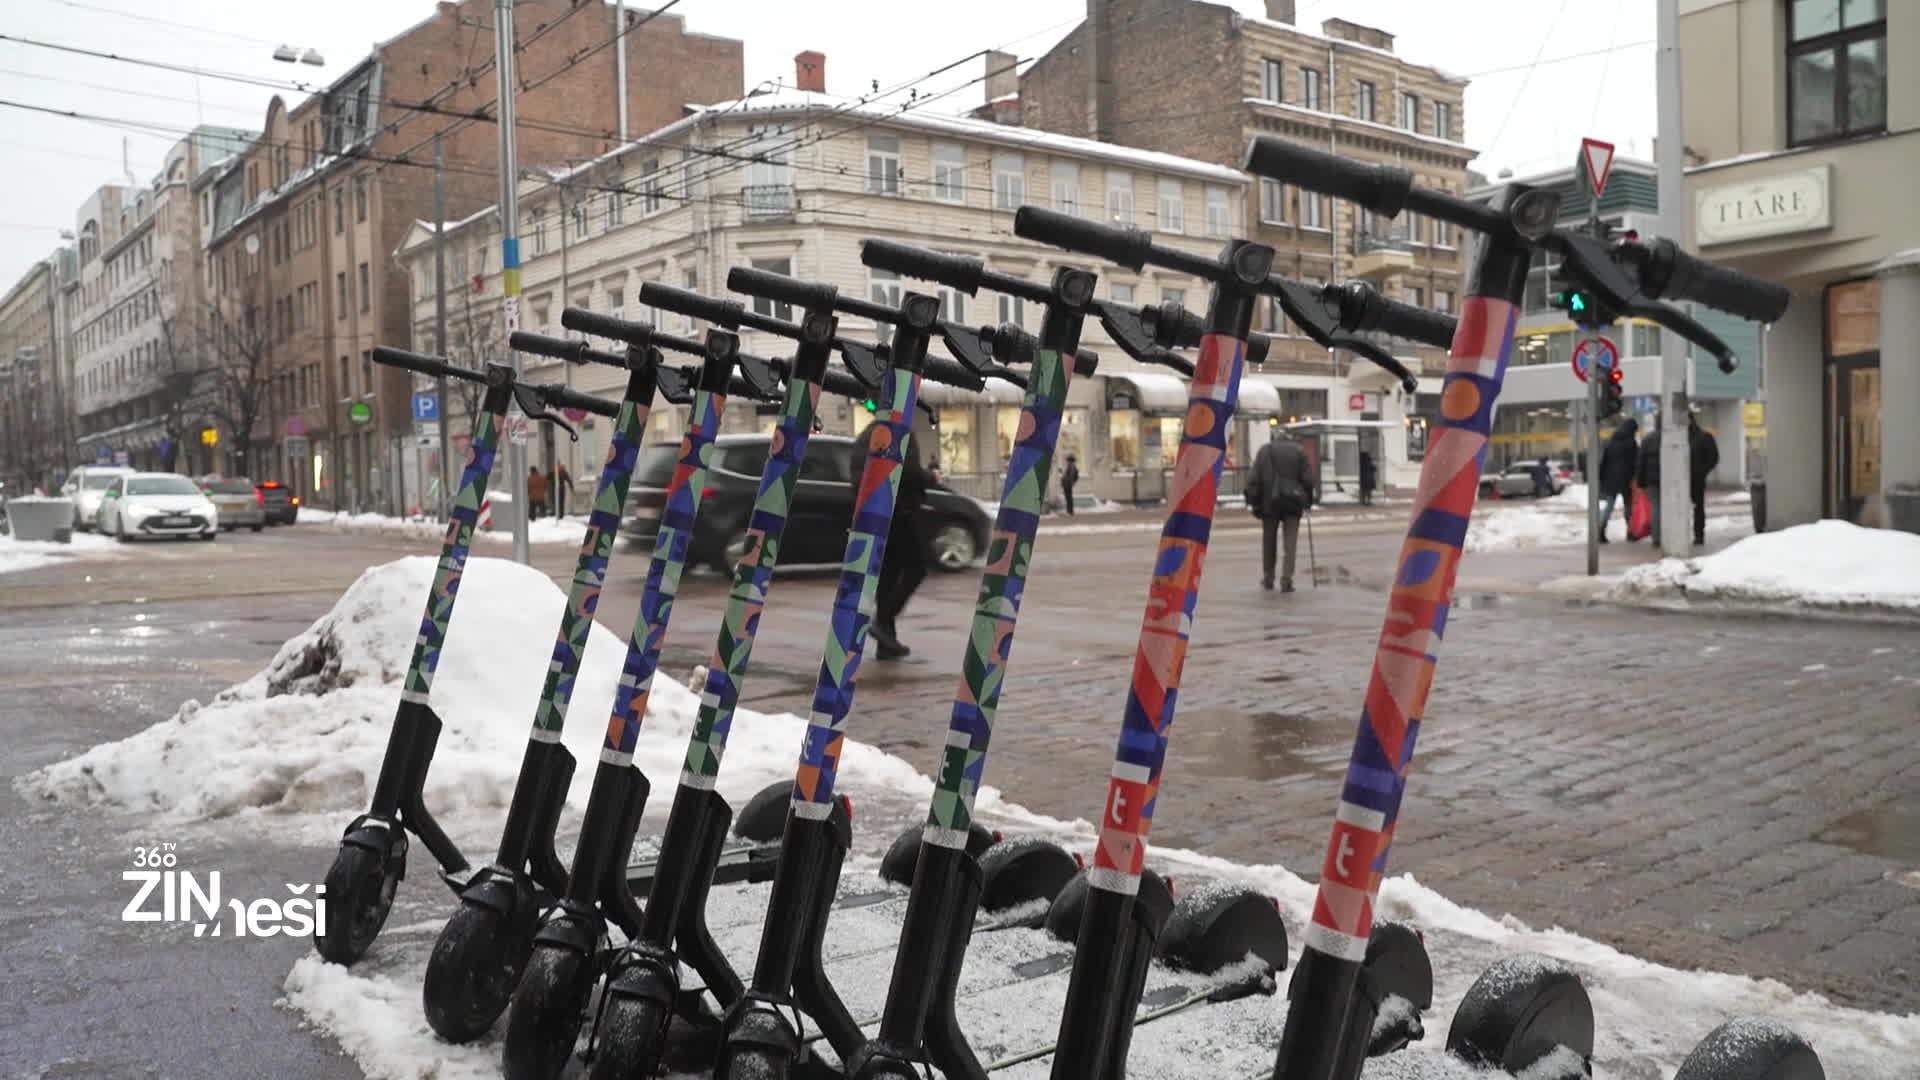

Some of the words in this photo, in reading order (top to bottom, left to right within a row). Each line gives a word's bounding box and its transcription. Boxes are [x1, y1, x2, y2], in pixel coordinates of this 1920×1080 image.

[1714, 190, 1807, 223] TIARE
[418, 397, 434, 417] P
[1335, 831, 1355, 880] t
